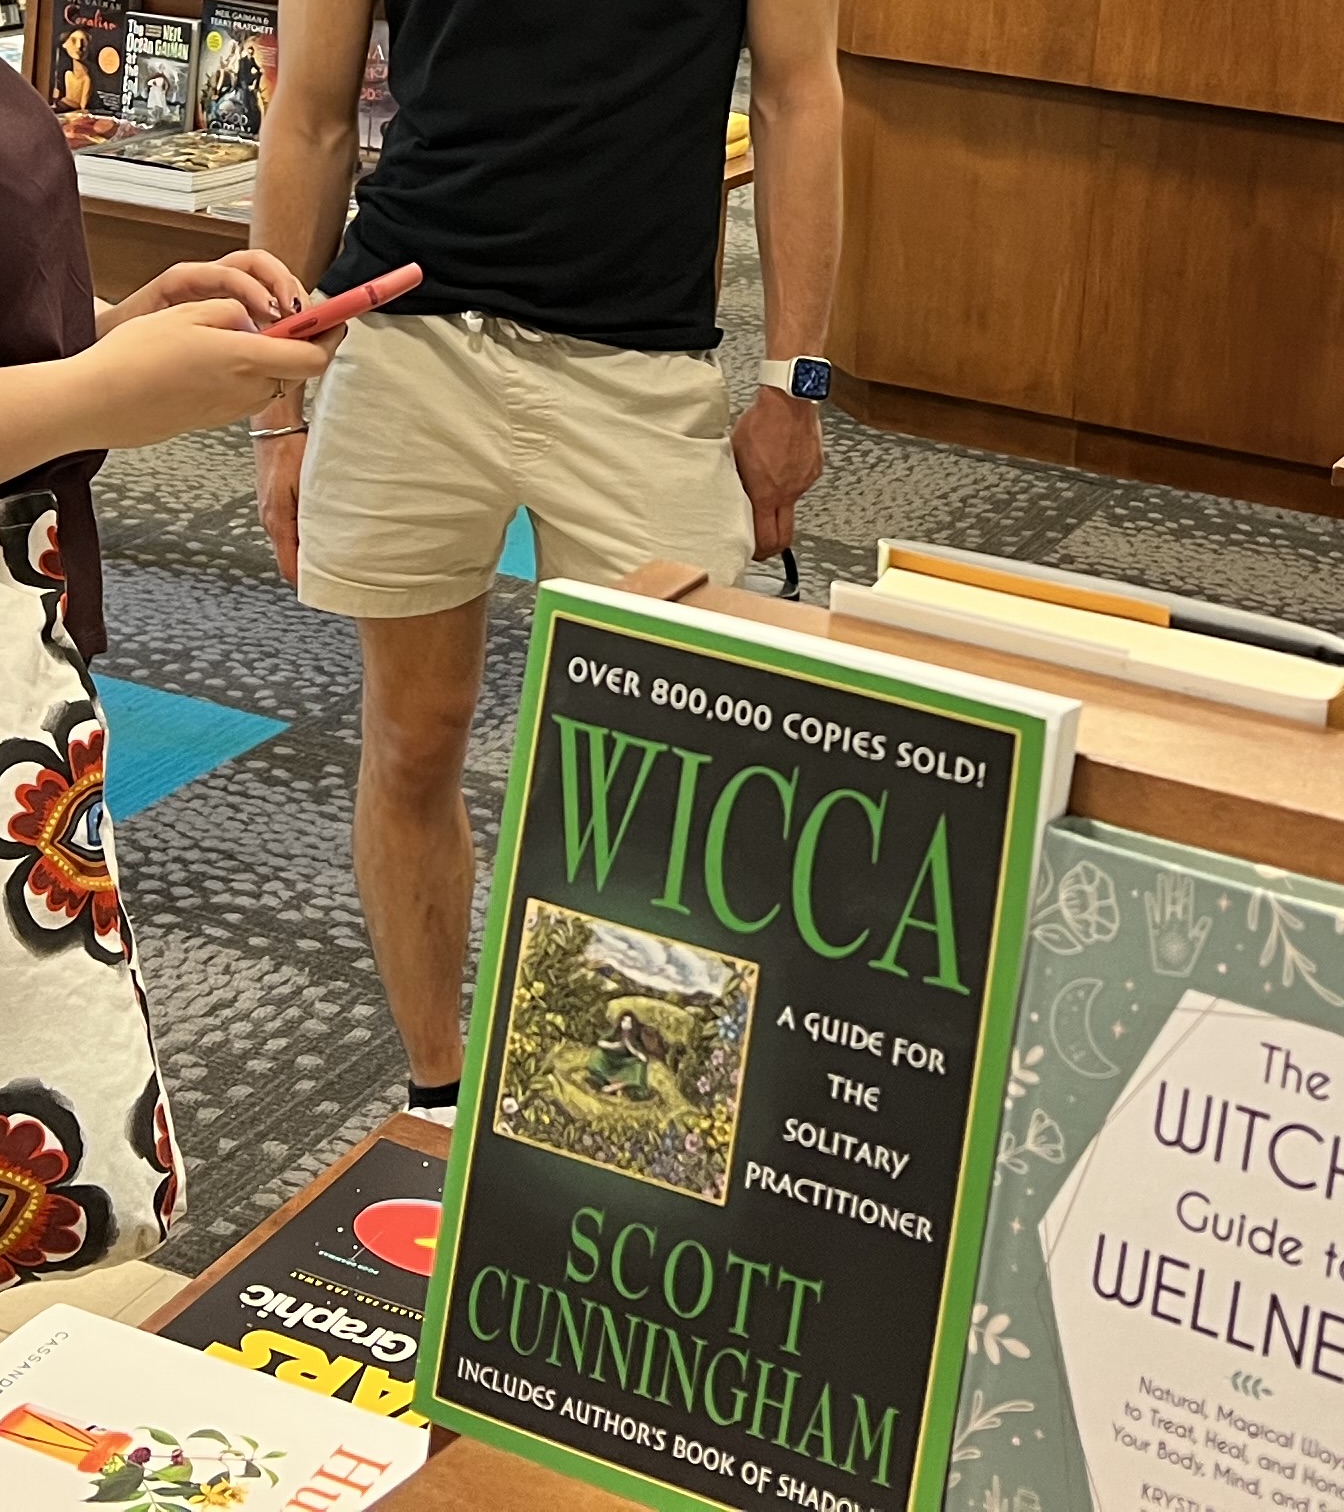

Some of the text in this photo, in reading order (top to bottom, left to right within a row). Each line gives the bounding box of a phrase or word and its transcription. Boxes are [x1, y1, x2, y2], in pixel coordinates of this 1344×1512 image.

[127, 18, 145, 36] The
[154, 39, 190, 61] GAIMAN
[162, 23, 184, 43] NEIL
[214, 8, 231, 19] NEIL
[567, 657, 989, 790] OVER 800,000 COPIES SOLD!
[551, 714, 971, 996] WICCA
[777, 1005, 947, 1076] A GUIDE FOR
[1260, 1041, 1331, 1102] The
[827, 1072, 881, 1113] THE
[782, 1117, 912, 1181] SOLITARY
[744, 1160, 935, 1244] PRACTITIONER
[1176, 1190, 1304, 1267] Guide
[289, 1270, 324, 1287] AWAY
[565, 1205, 823, 1357] SCOTT
[239, 1284, 418, 1363] Graphic
[466, 1265, 900, 1489] CUNNINGHAM
[1138, 1375, 1209, 1420] Natural,
[1216, 1404, 1296, 1450] Magical
[457, 1355, 556, 1413] INCLUDES
[559, 1397, 668, 1453] AUTHOR'S
[673, 1431, 735, 1479] BOOK
[741, 1459, 772, 1493] OF
[1112, 1421, 1151, 1453] Your
[1213, 1461, 1264, 1501] Mind,
[1124, 1400, 1143, 1421] to
[1150, 1408, 1197, 1445] Treat,
[1205, 1430, 1251, 1466] Heal,
[1258, 1453, 1297, 1480] and
[285, 1444, 393, 1512] Hu
